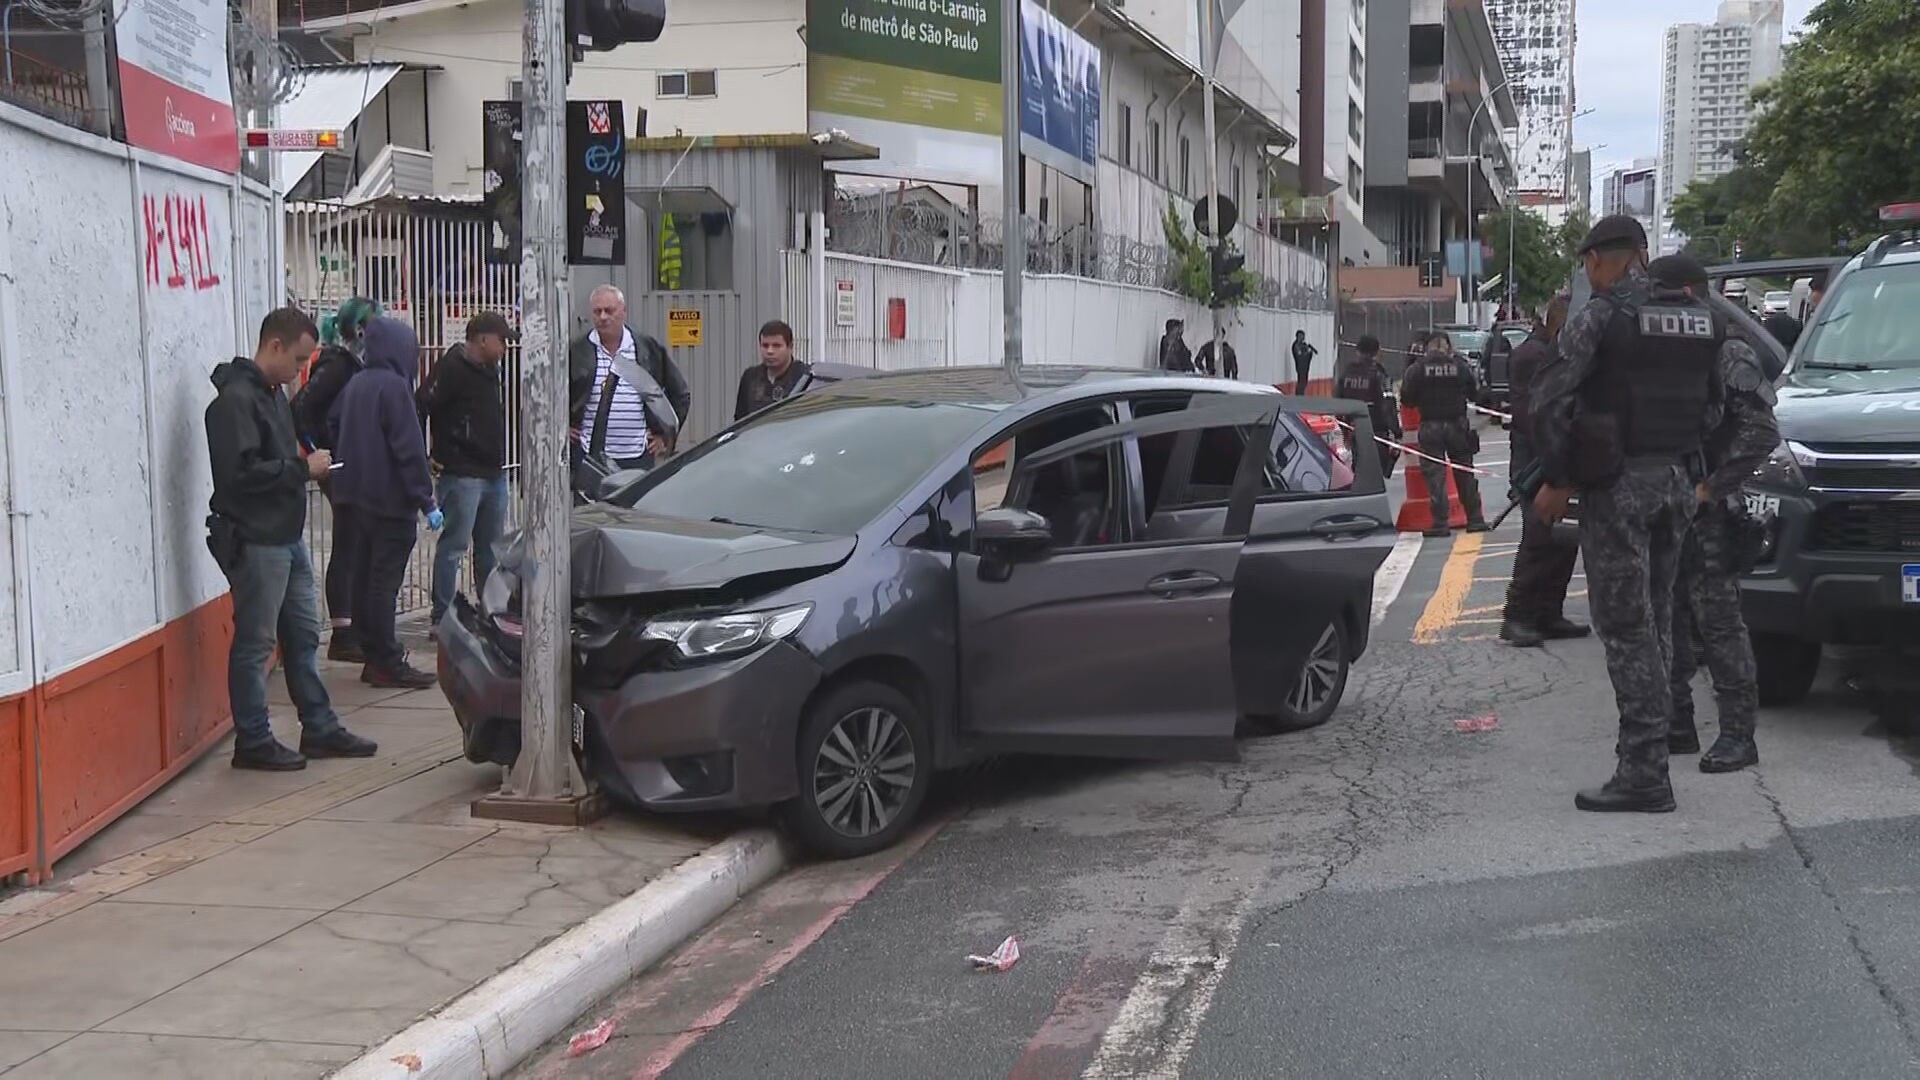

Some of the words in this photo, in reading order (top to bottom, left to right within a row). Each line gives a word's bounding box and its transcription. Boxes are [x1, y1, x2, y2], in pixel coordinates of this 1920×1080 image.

[841, 8, 856, 29] de
[860, 15, 898, 37] metrô
[901, 18, 916, 41] de
[919, 23, 941, 45] São
[944, 27, 979, 52] Paulo
